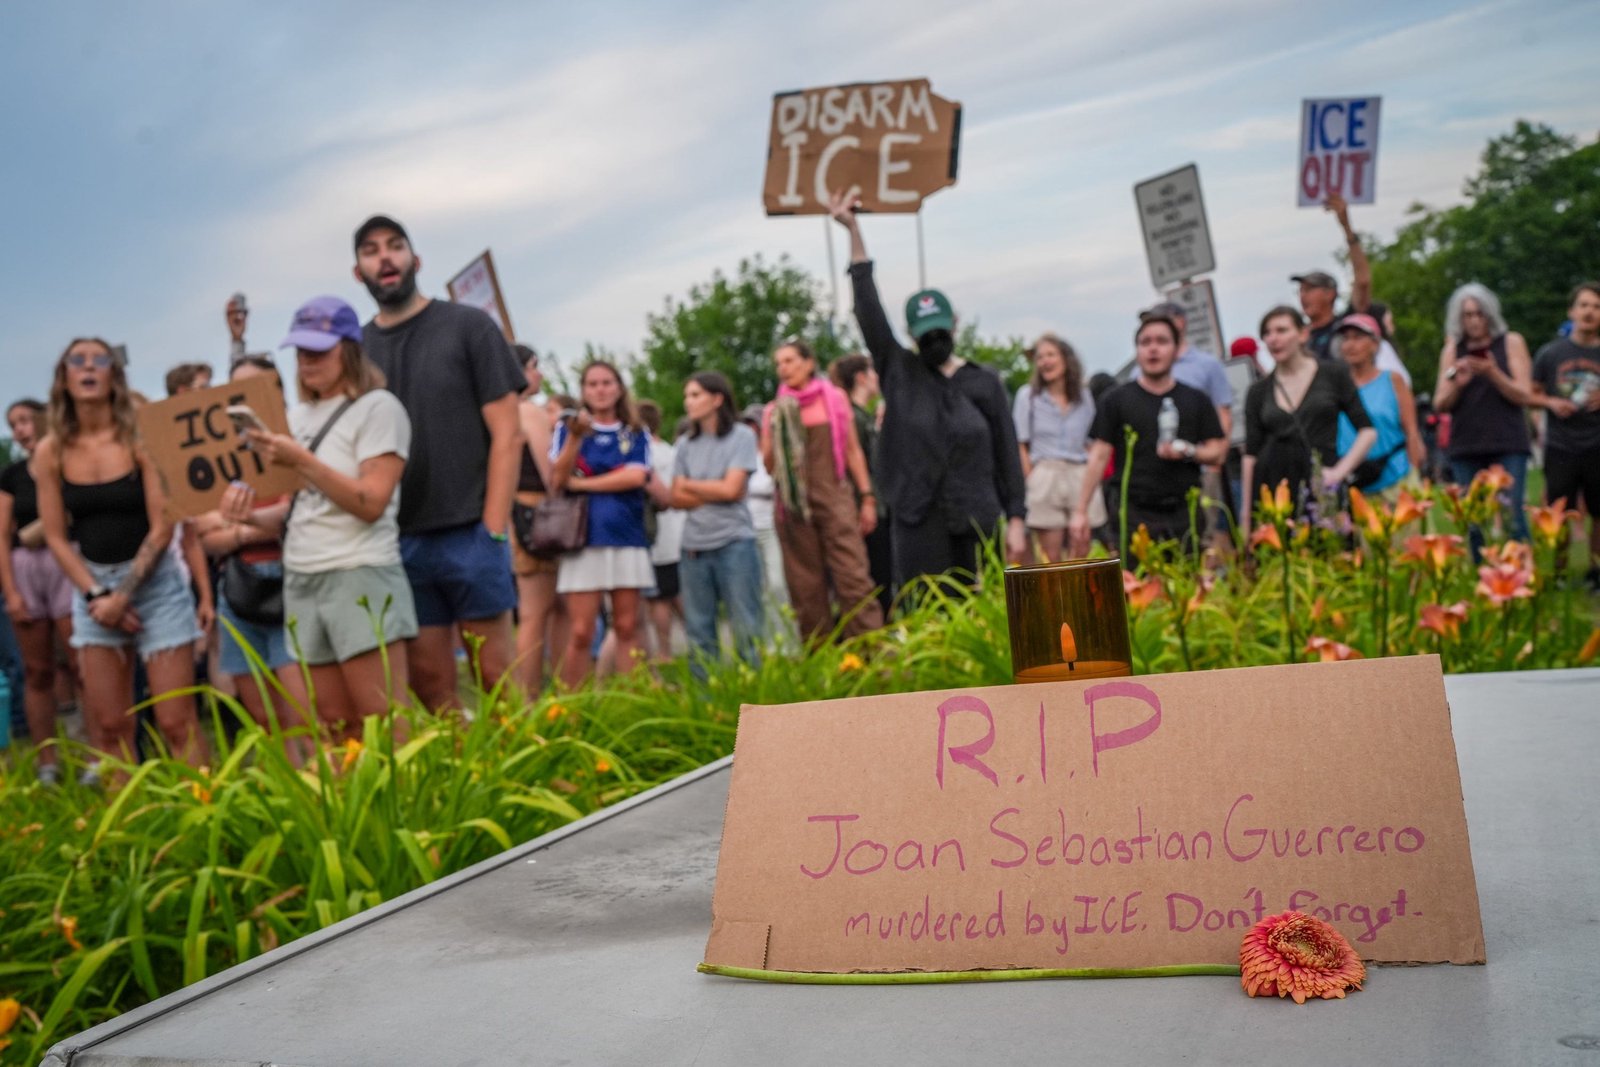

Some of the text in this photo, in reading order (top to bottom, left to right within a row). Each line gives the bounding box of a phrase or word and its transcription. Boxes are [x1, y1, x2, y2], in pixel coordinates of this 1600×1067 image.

[777, 85, 938, 135] DISARM
[1308, 101, 1368, 151] ICE
[778, 132, 922, 207] ICE
[1301, 152, 1371, 199] OUT
[936, 682, 1161, 790] R.I.P
[800, 794, 1425, 880] Joan Sebastian Guerrero
[845, 889, 1006, 942] murdered
[1026, 900, 1069, 955] by
[1074, 891, 1148, 935] ICE.
[1165, 887, 1266, 932] Don't
